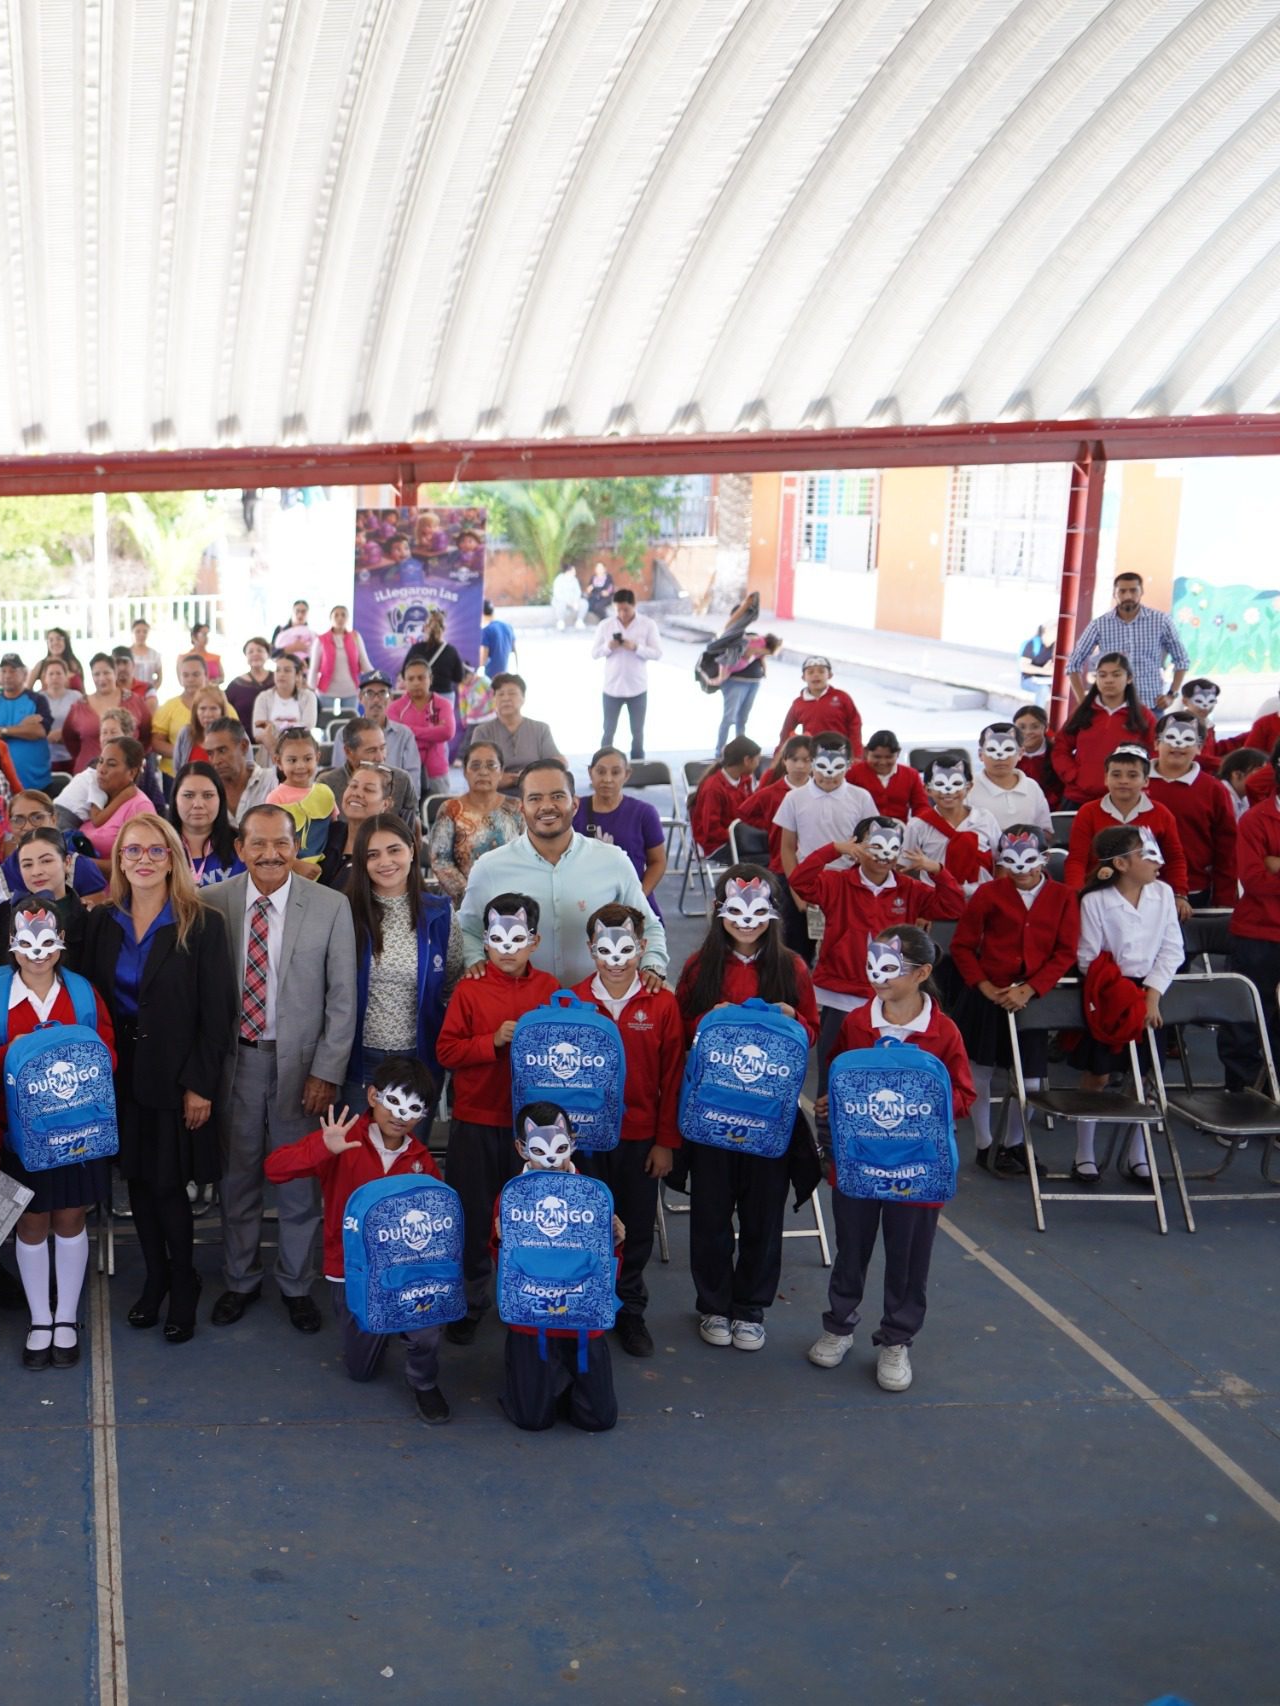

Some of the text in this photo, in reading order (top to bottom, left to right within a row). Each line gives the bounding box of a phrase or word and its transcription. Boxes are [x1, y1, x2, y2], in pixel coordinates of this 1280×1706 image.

[368, 671, 382, 680] A
[200, 867, 232, 887] NY
[526, 1053, 605, 1067] DURANGO
[710, 1051, 790, 1077] DURANGO
[28, 1065, 99, 1095] DURANGO
[845, 1102, 932, 1117] DURANGO
[704, 1110, 767, 1129] MOCHULA
[712, 1122, 749, 1139] 30
[863, 1165, 926, 1180] MOCHULA
[511, 1208, 595, 1223] DURANGO
[378, 1216, 453, 1242] DURANGO
